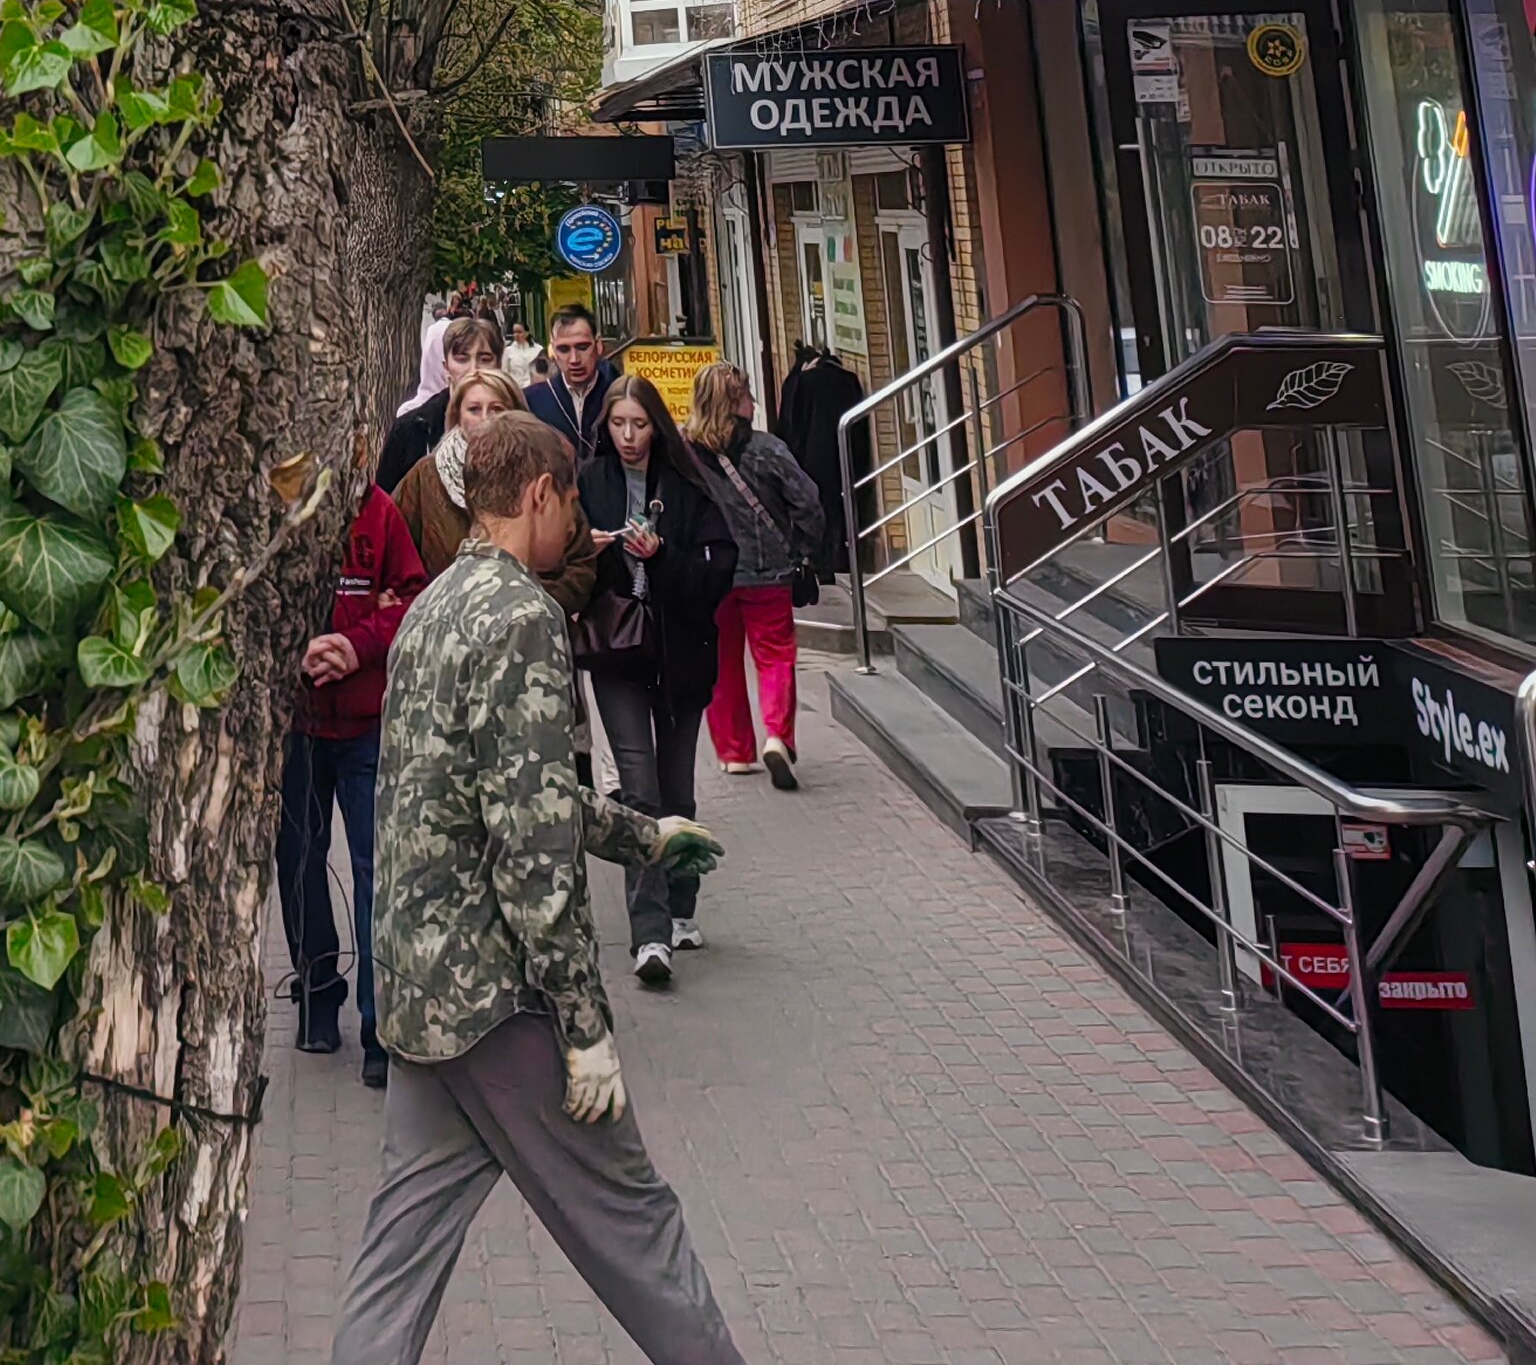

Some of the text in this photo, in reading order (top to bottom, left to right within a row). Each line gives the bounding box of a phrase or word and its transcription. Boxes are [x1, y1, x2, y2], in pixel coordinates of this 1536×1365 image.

[733, 57, 941, 93] МУЖСКАЯ
[750, 95, 933, 137] ОДЕЖДА
[1195, 162, 1276, 176] ОТКРЫТО
[1219, 194, 1271, 205] ТАБАК
[1200, 225, 1233, 248] 08
[1250, 225, 1284, 248] 22
[1424, 260, 1484, 293] SMOKING
[628, 350, 713, 364] БЕЛОРУССКАЯ
[636, 366, 700, 379] КОСМЕТИК
[1031, 396, 1213, 531] ТАБАК
[1192, 654, 1381, 687] стильный
[1222, 693, 1359, 726] секонд
[1411, 676, 1511, 774] Style.ex
